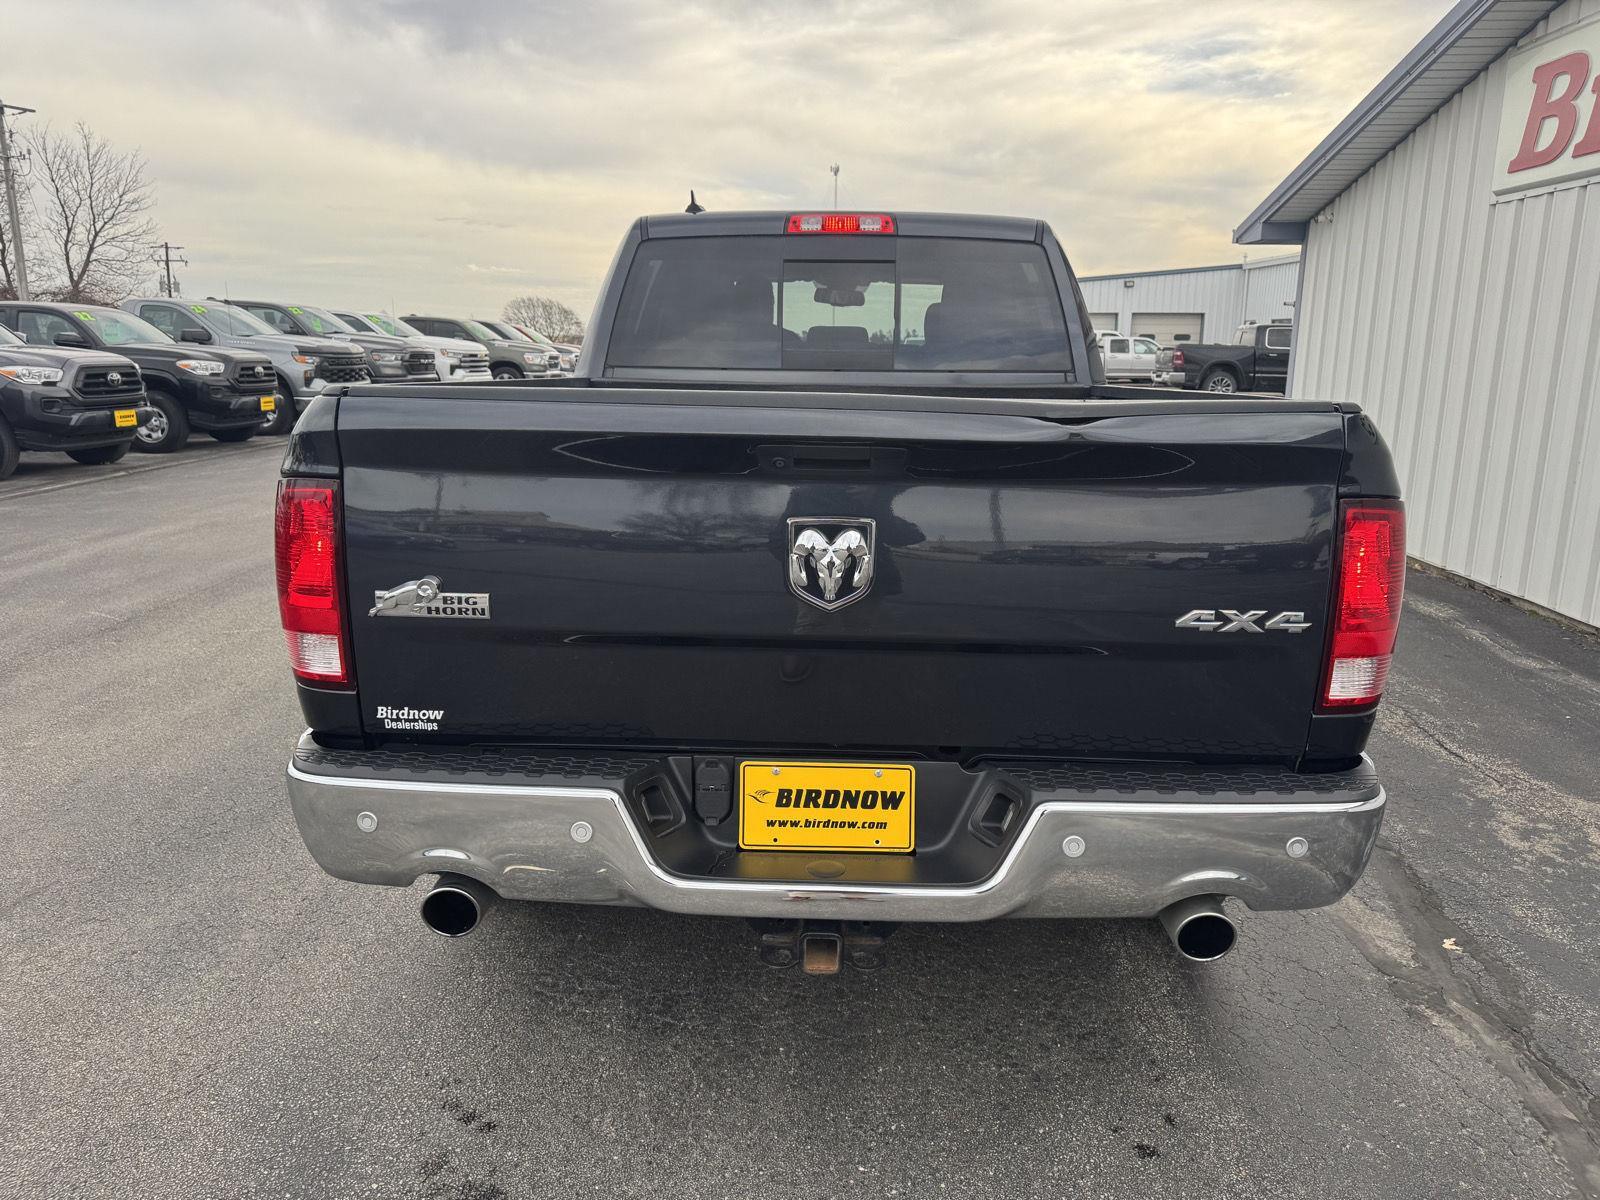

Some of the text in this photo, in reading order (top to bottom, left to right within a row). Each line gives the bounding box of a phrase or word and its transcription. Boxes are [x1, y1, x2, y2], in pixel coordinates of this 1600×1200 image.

[442, 595, 479, 606] BIG
[427, 606, 487, 617] HORN
[376, 706, 445, 720] Birdnow
[384, 719, 439, 731] Dealerships
[774, 788, 906, 811] BIRDNOW
[766, 818, 888, 830] www.birdnow.com
